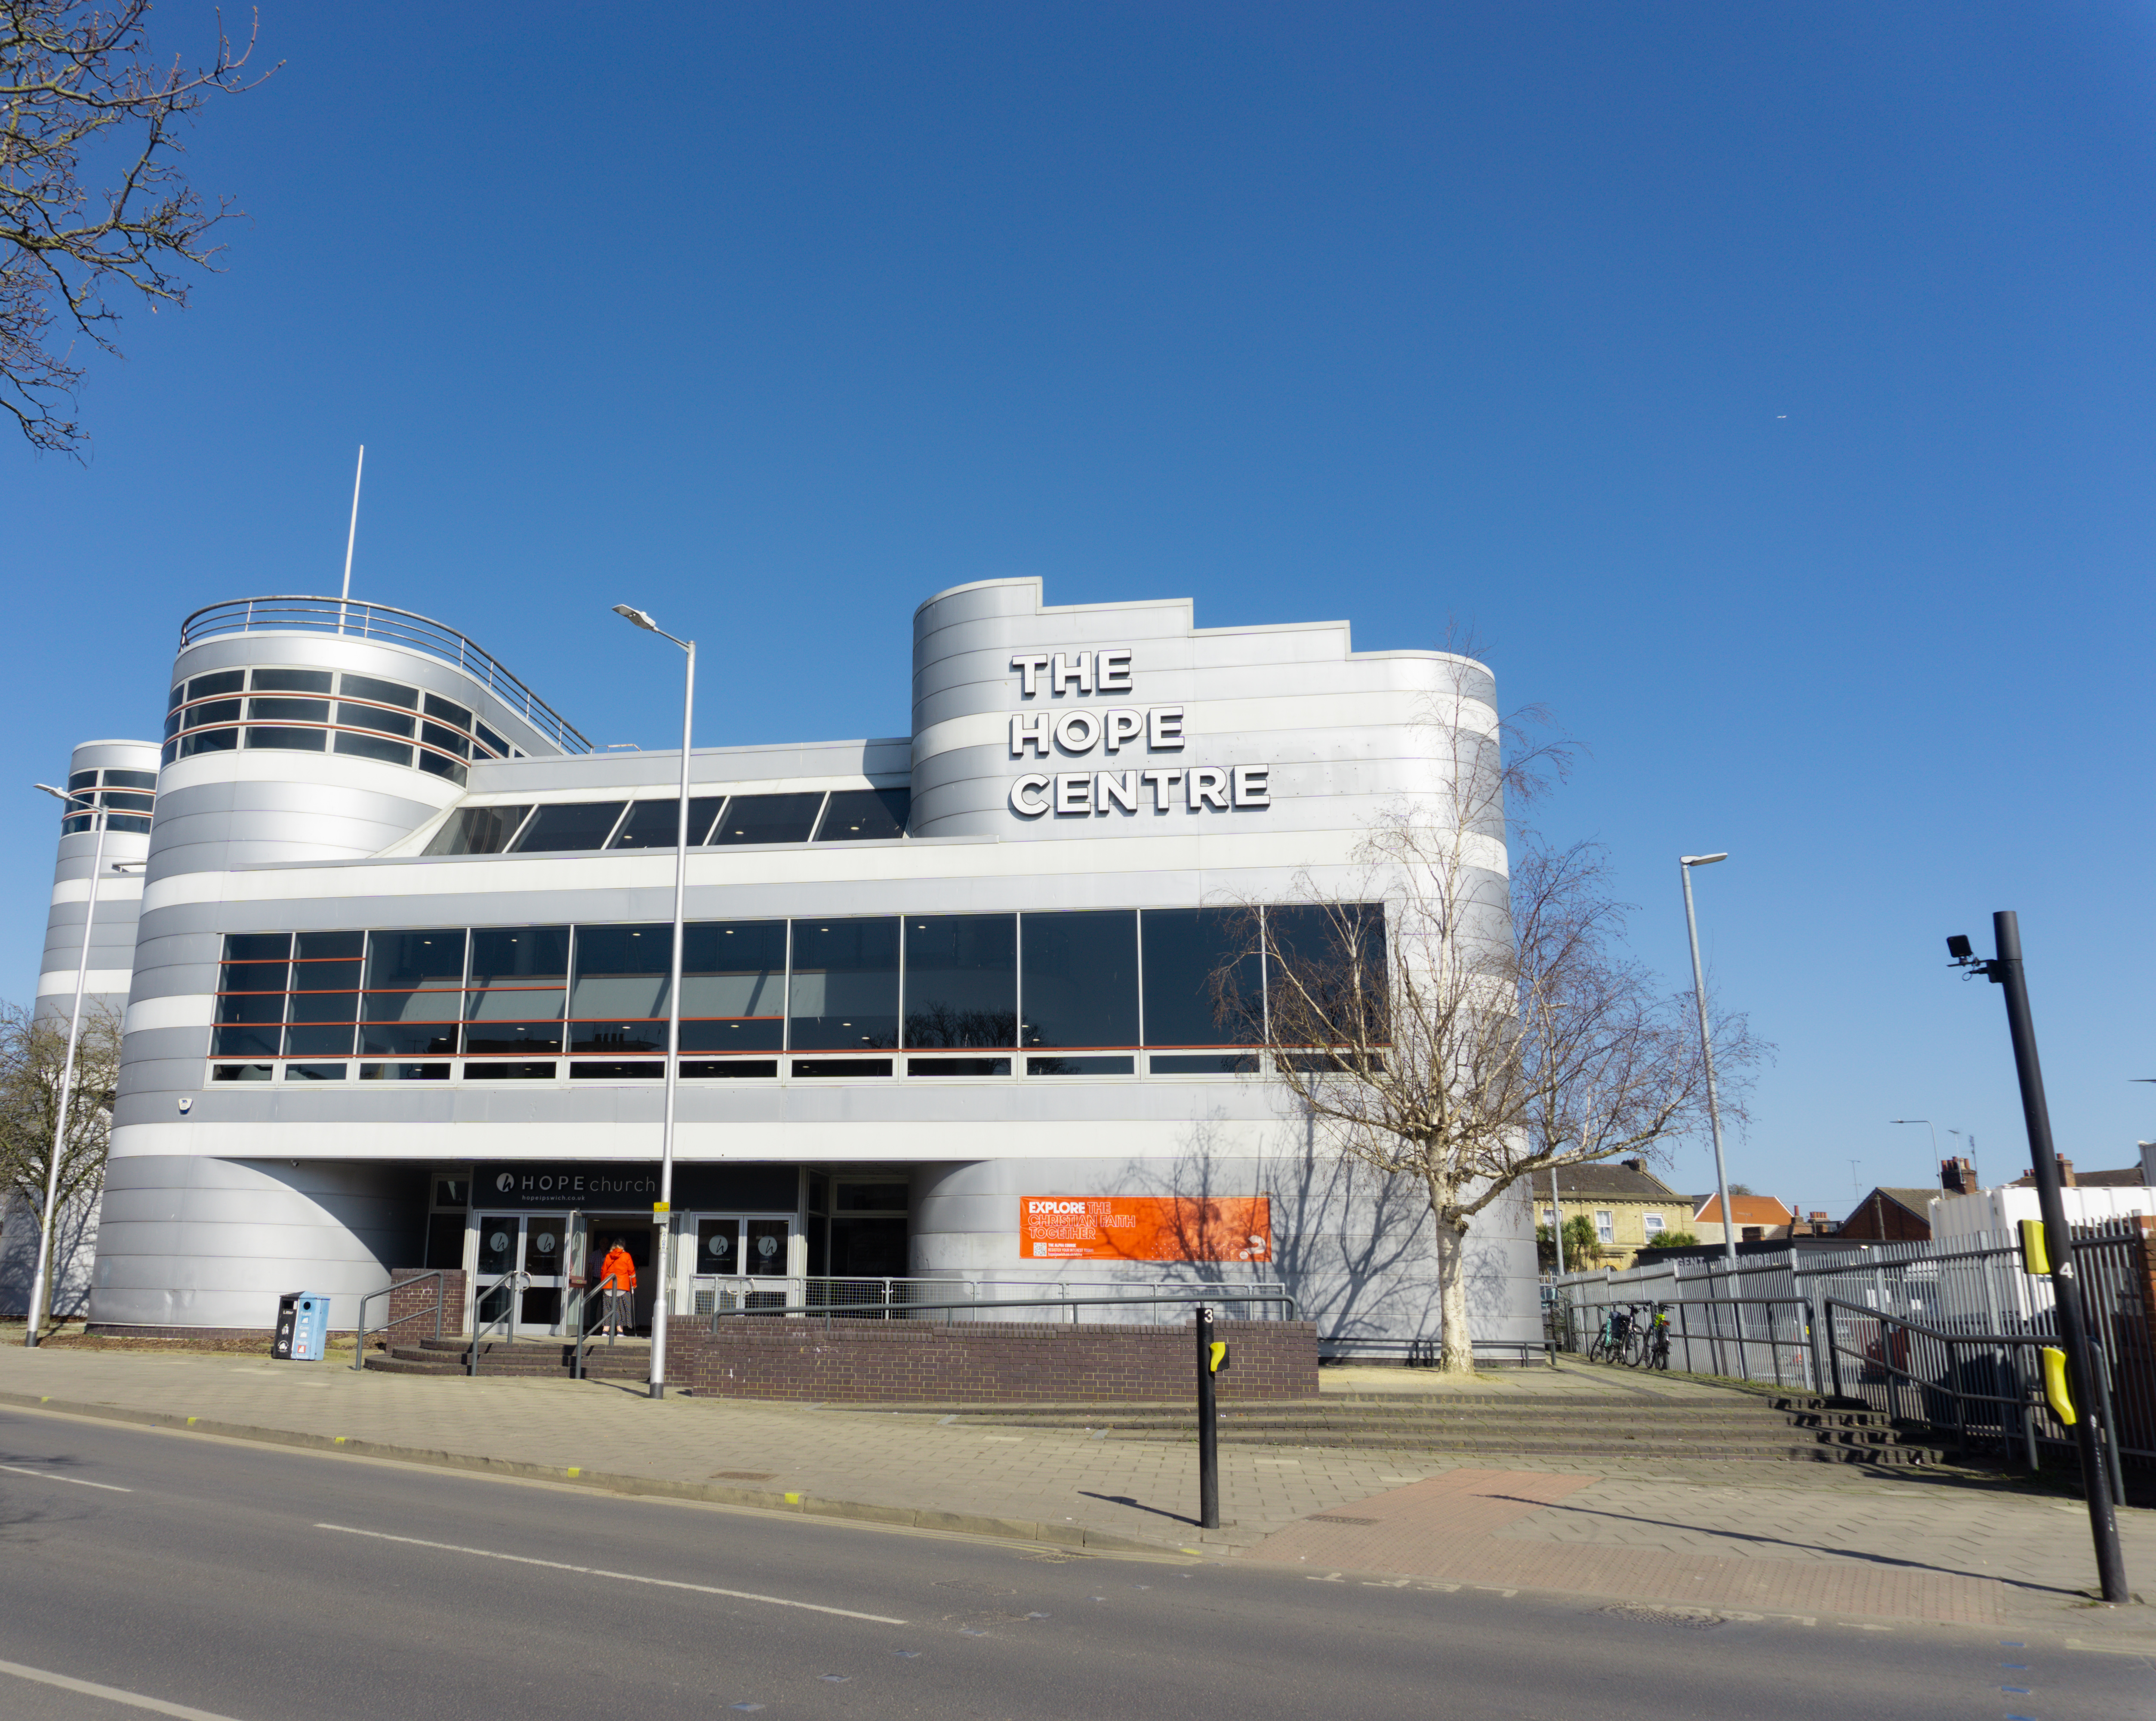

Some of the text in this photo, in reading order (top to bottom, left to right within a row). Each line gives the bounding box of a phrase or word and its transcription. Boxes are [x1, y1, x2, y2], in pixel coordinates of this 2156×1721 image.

[1012, 649, 1132, 694] THE
[1012, 706, 1185, 756] HOPE
[1010, 763, 1270, 816] CENTRE
[522, 1175, 584, 1191] HOPE
[590, 1176, 655, 1191] church
[1029, 1202, 1111, 1214] EXPLORE THE
[1028, 1215, 1136, 1228] CHRISTIAN FAITH
[1029, 1227, 1096, 1239] TOGETHER
[2059, 1262, 2074, 1279] 4
[1204, 1309, 1213, 1323] 3
